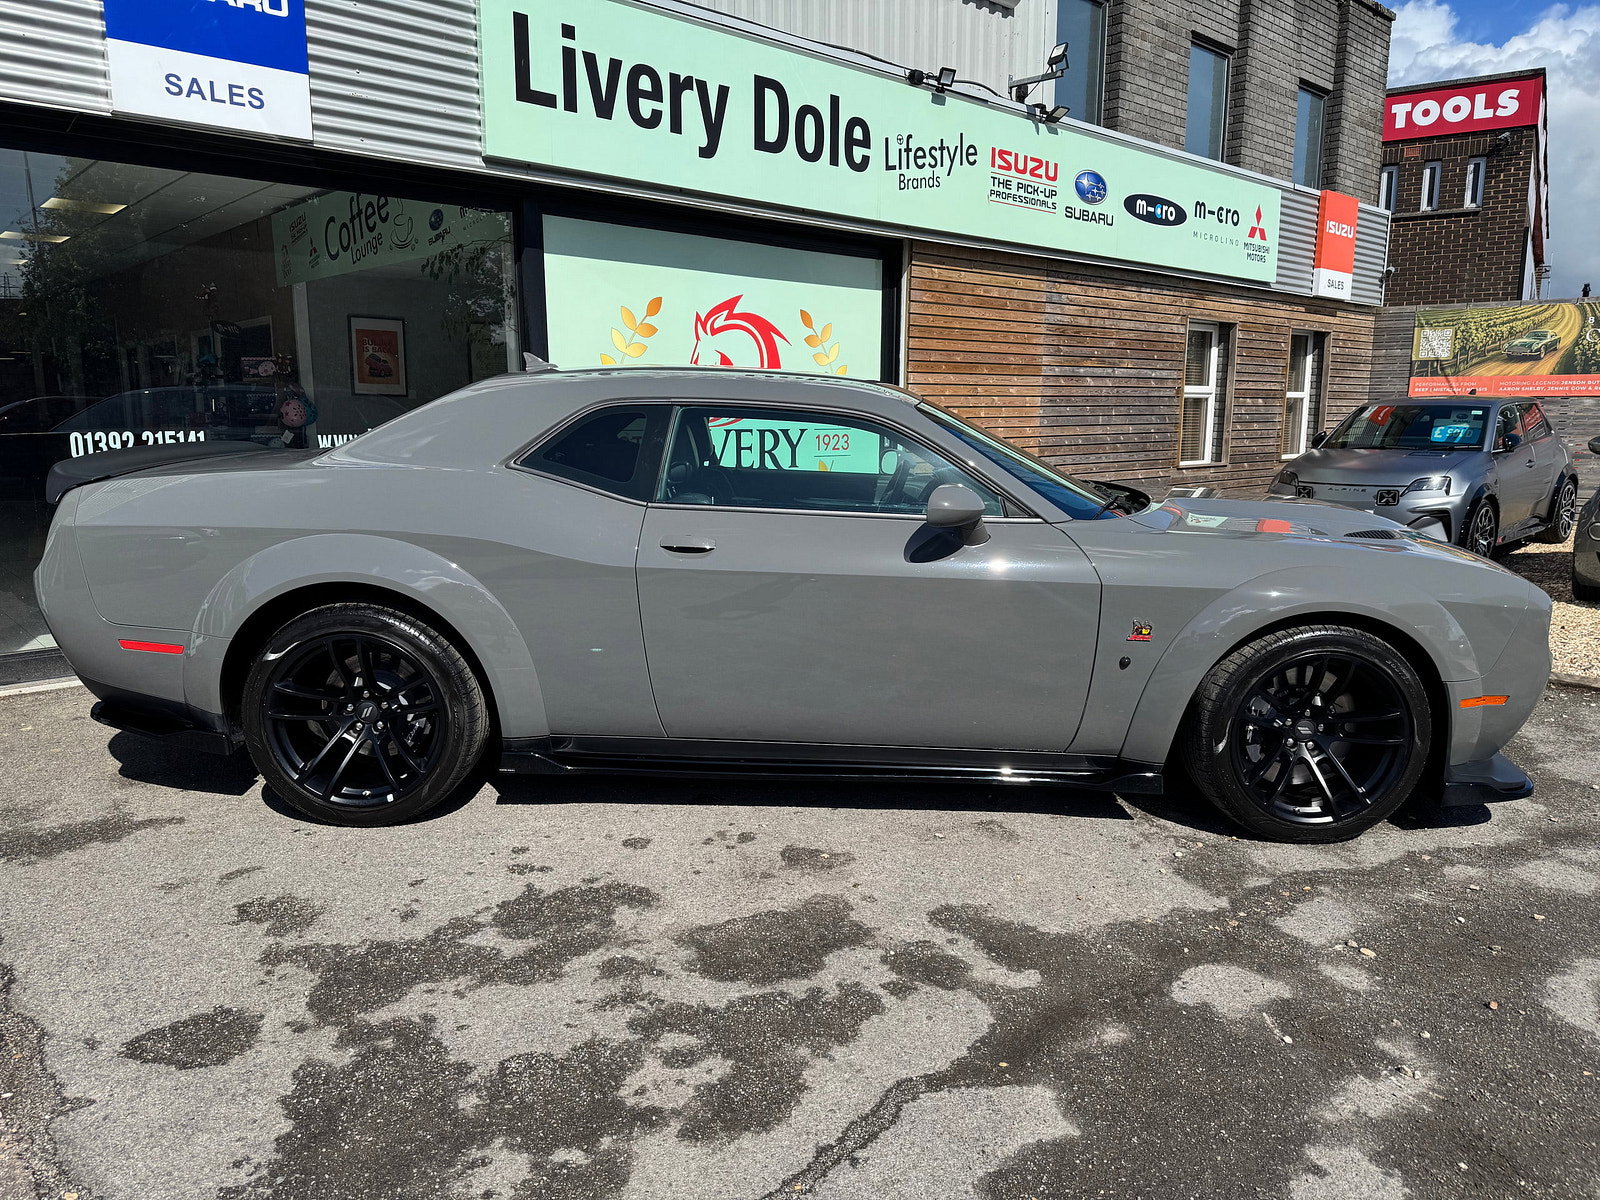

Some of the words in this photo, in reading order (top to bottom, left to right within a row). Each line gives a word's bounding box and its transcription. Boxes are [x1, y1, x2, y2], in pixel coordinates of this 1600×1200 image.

[164, 73, 266, 110] SALES
[512, 10, 731, 160] Livery
[753, 73, 872, 173] Dole
[1391, 89, 1520, 129] TOOLS
[884, 132, 978, 177] Lifestyle
[990, 146, 1059, 182] ISUZU
[898, 170, 941, 191] Brands
[990, 176, 1013, 192] THE
[1016, 181, 1058, 200] PICK-UP
[989, 189, 1057, 210] PROFESSIONALS
[325, 193, 389, 261] Coffee
[1064, 206, 1114, 227] SUBARU
[1193, 230, 1240, 247] MICROLINO
[1326, 220, 1354, 239] ISUZU
[350, 232, 383, 265] Lounge
[1243, 242, 1270, 255] MITSUBISHI
[1247, 252, 1267, 264] MOTORS
[1326, 278, 1345, 291] SALES
[69, 431, 135, 458] 01392
[815, 433, 850, 451] 1923
